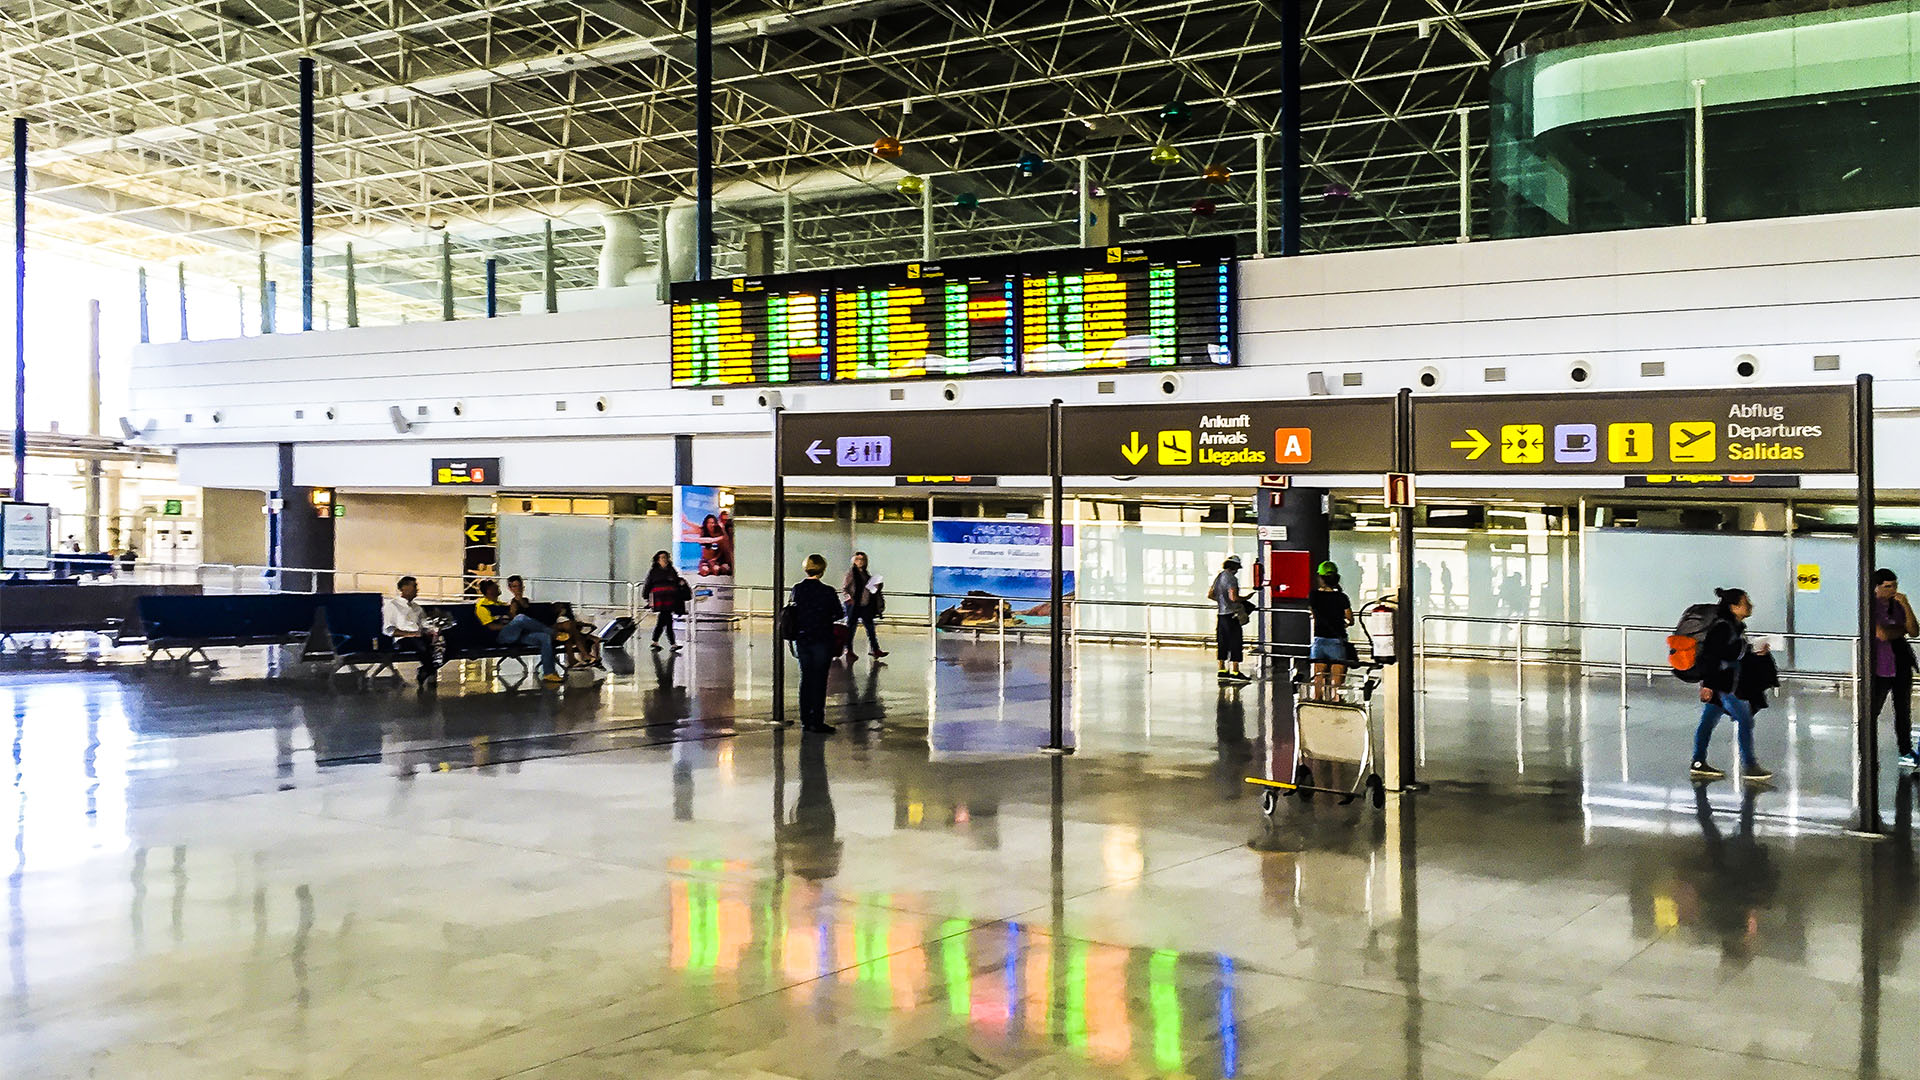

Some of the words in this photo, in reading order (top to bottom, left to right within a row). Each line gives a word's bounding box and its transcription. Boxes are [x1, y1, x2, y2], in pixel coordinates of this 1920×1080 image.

[1728, 403, 1785, 420] Abflug
[1199, 414, 1250, 428] Ankunft
[1199, 431, 1248, 445] Arrivals
[1727, 423, 1823, 440] Departures
[1284, 435, 1302, 457] A
[1728, 443, 1805, 460] Salidas
[1199, 448, 1266, 466] Llegadas
